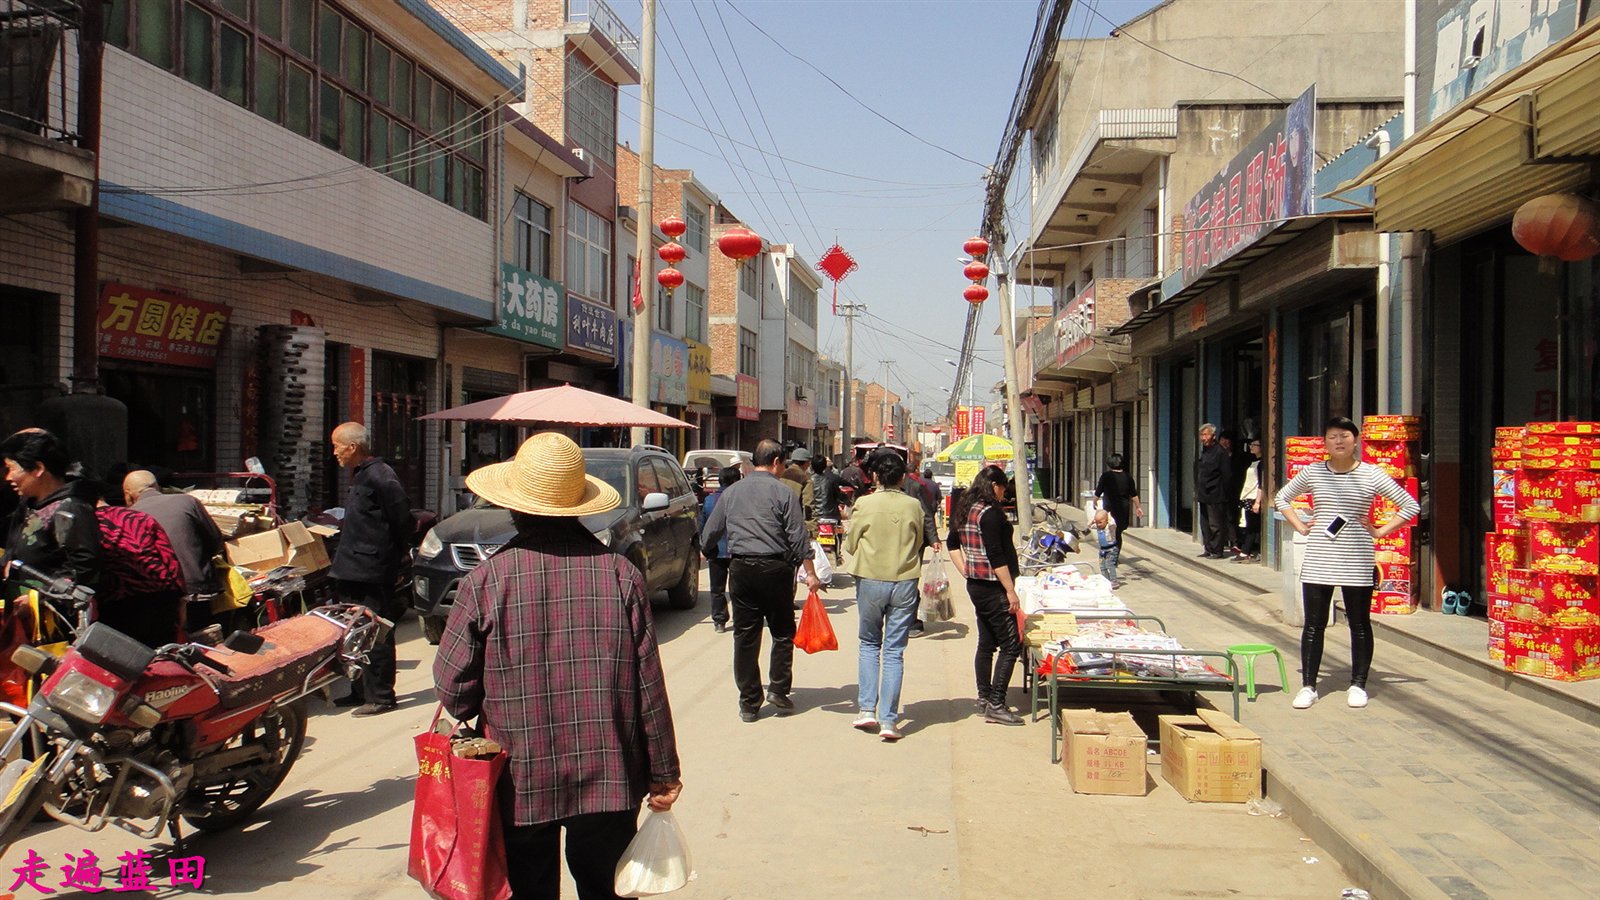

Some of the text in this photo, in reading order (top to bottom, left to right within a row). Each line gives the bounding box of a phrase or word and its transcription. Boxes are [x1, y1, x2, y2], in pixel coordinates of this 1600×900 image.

[100, 292, 227, 345] 方圆馍店
[511, 319, 521, 331] da
[524, 325, 538, 336] yao
[541, 328, 557, 343] fang
